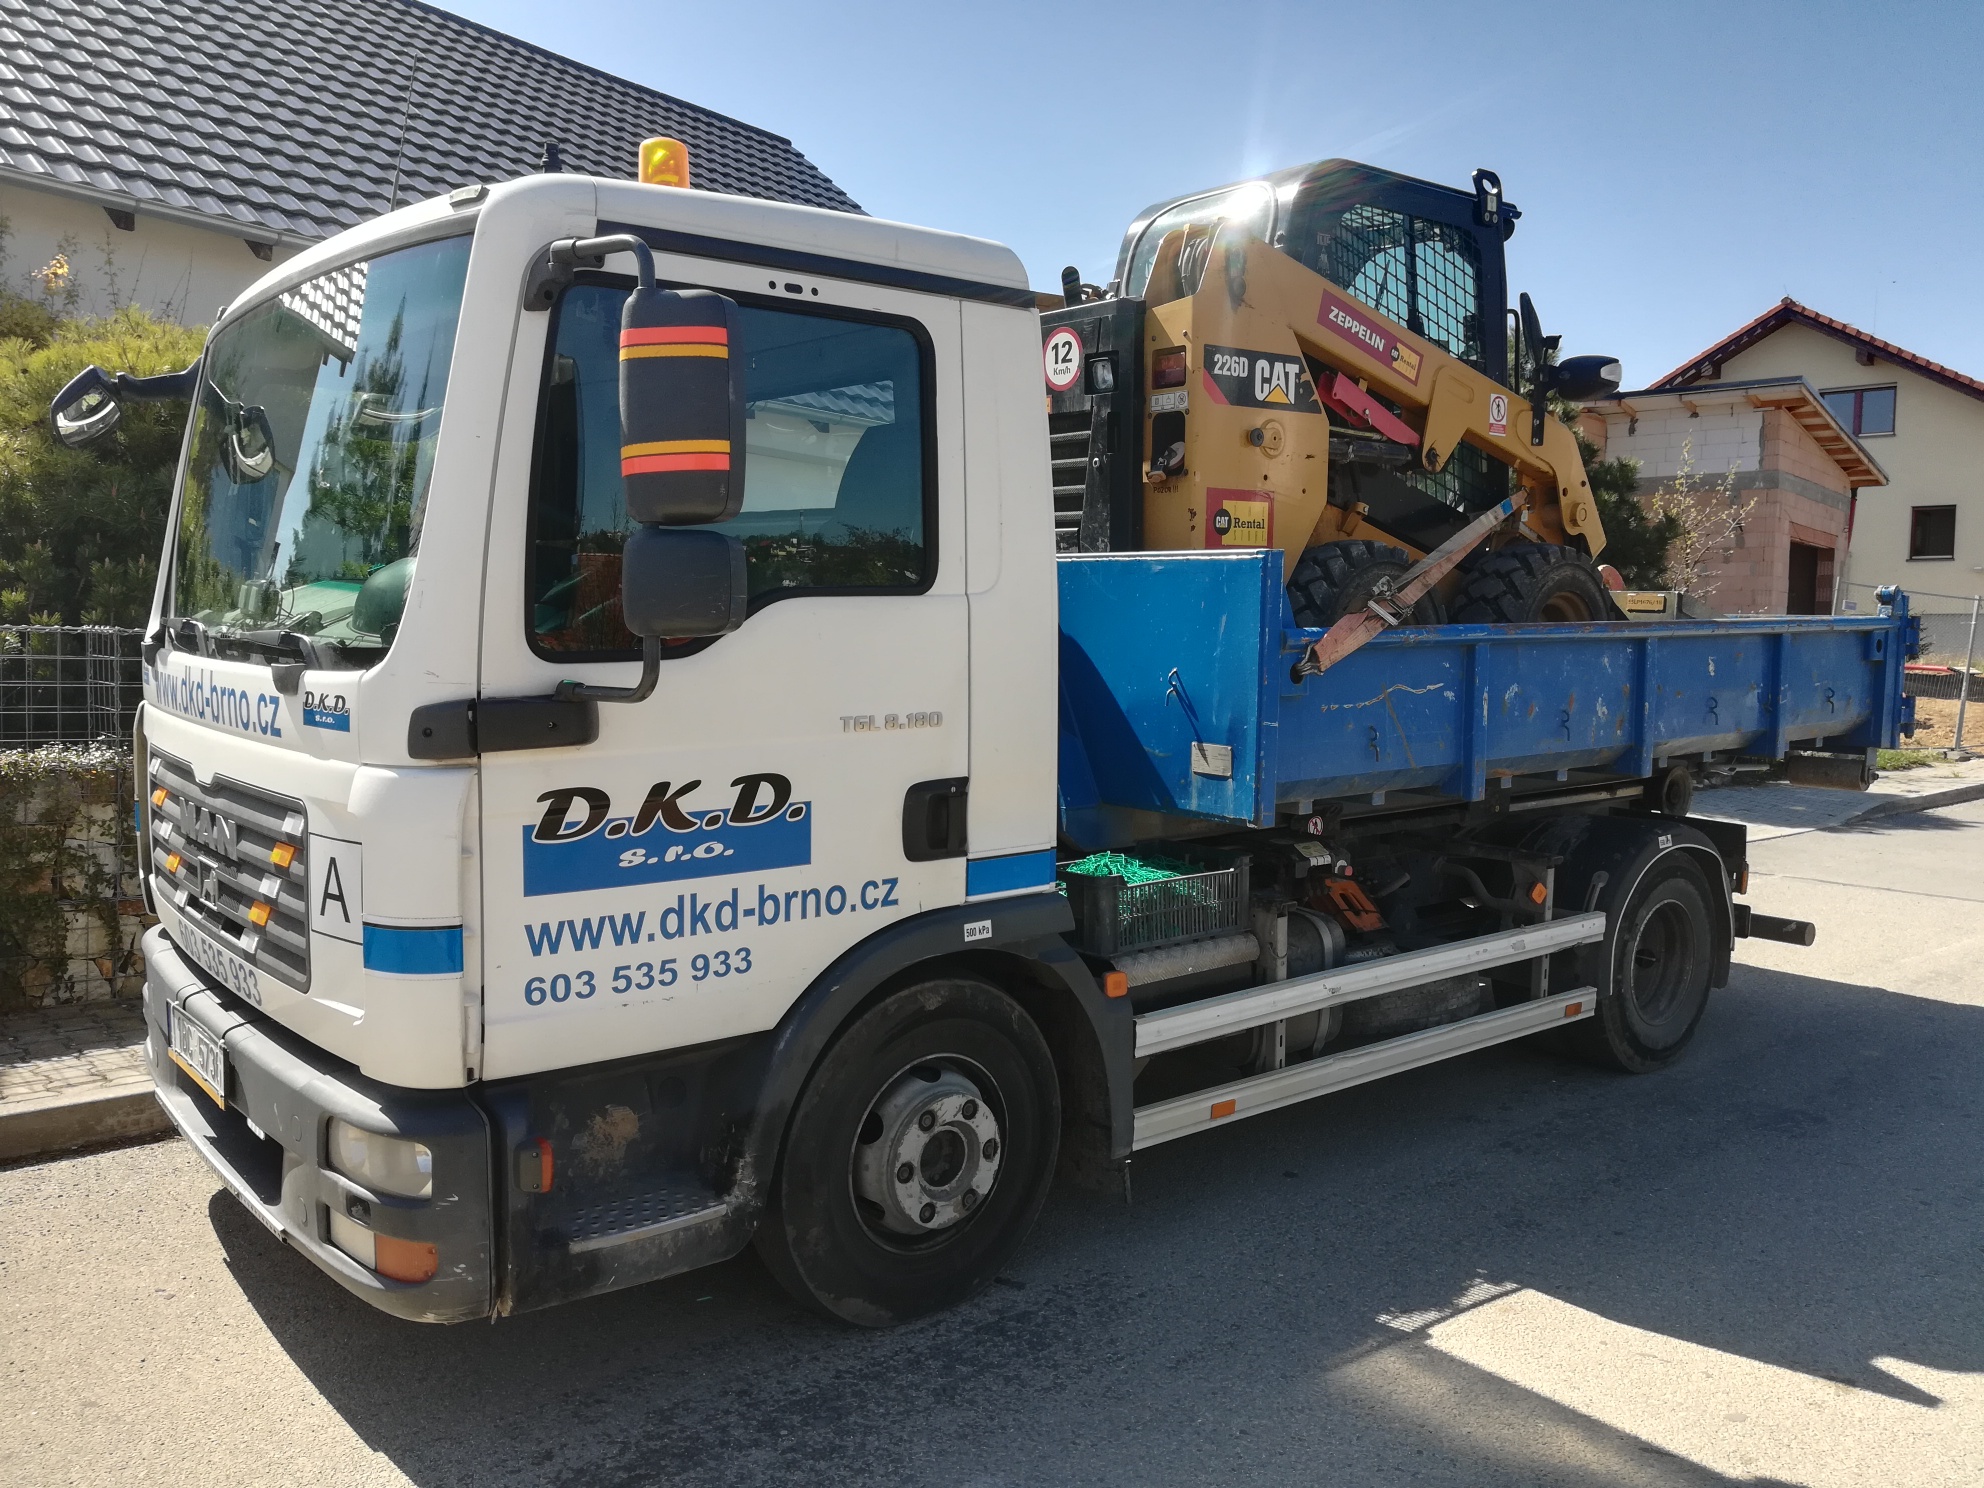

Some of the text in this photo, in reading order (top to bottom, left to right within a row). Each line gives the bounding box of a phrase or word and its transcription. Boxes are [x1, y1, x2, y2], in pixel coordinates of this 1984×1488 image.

[1051, 340, 1073, 365] 12
[1328, 305, 1385, 352] ZEPPELIN
[1400, 355, 1417, 371] Rental
[1053, 366, 1071, 376] Km/h
[1213, 353, 1300, 405] 226D CAT
[1215, 516, 1265, 530] CAT Rental
[156, 665, 281, 738] www.dkd-brno.cz
[304, 690, 350, 716] D.K.D.
[315, 715, 335, 724] s.r.o.
[840, 711, 943, 733] TGL 8.180
[179, 796, 237, 861] MAN
[530, 772, 807, 844] D.K.D.
[619, 841, 734, 868] s.r.o.
[320, 856, 350, 924] A
[524, 877, 899, 957] www.dkd-brno.cz
[966, 925, 990, 938] 500 kPa
[178, 917, 262, 1007] 603 535 933
[524, 947, 753, 1006] 603 535 933
